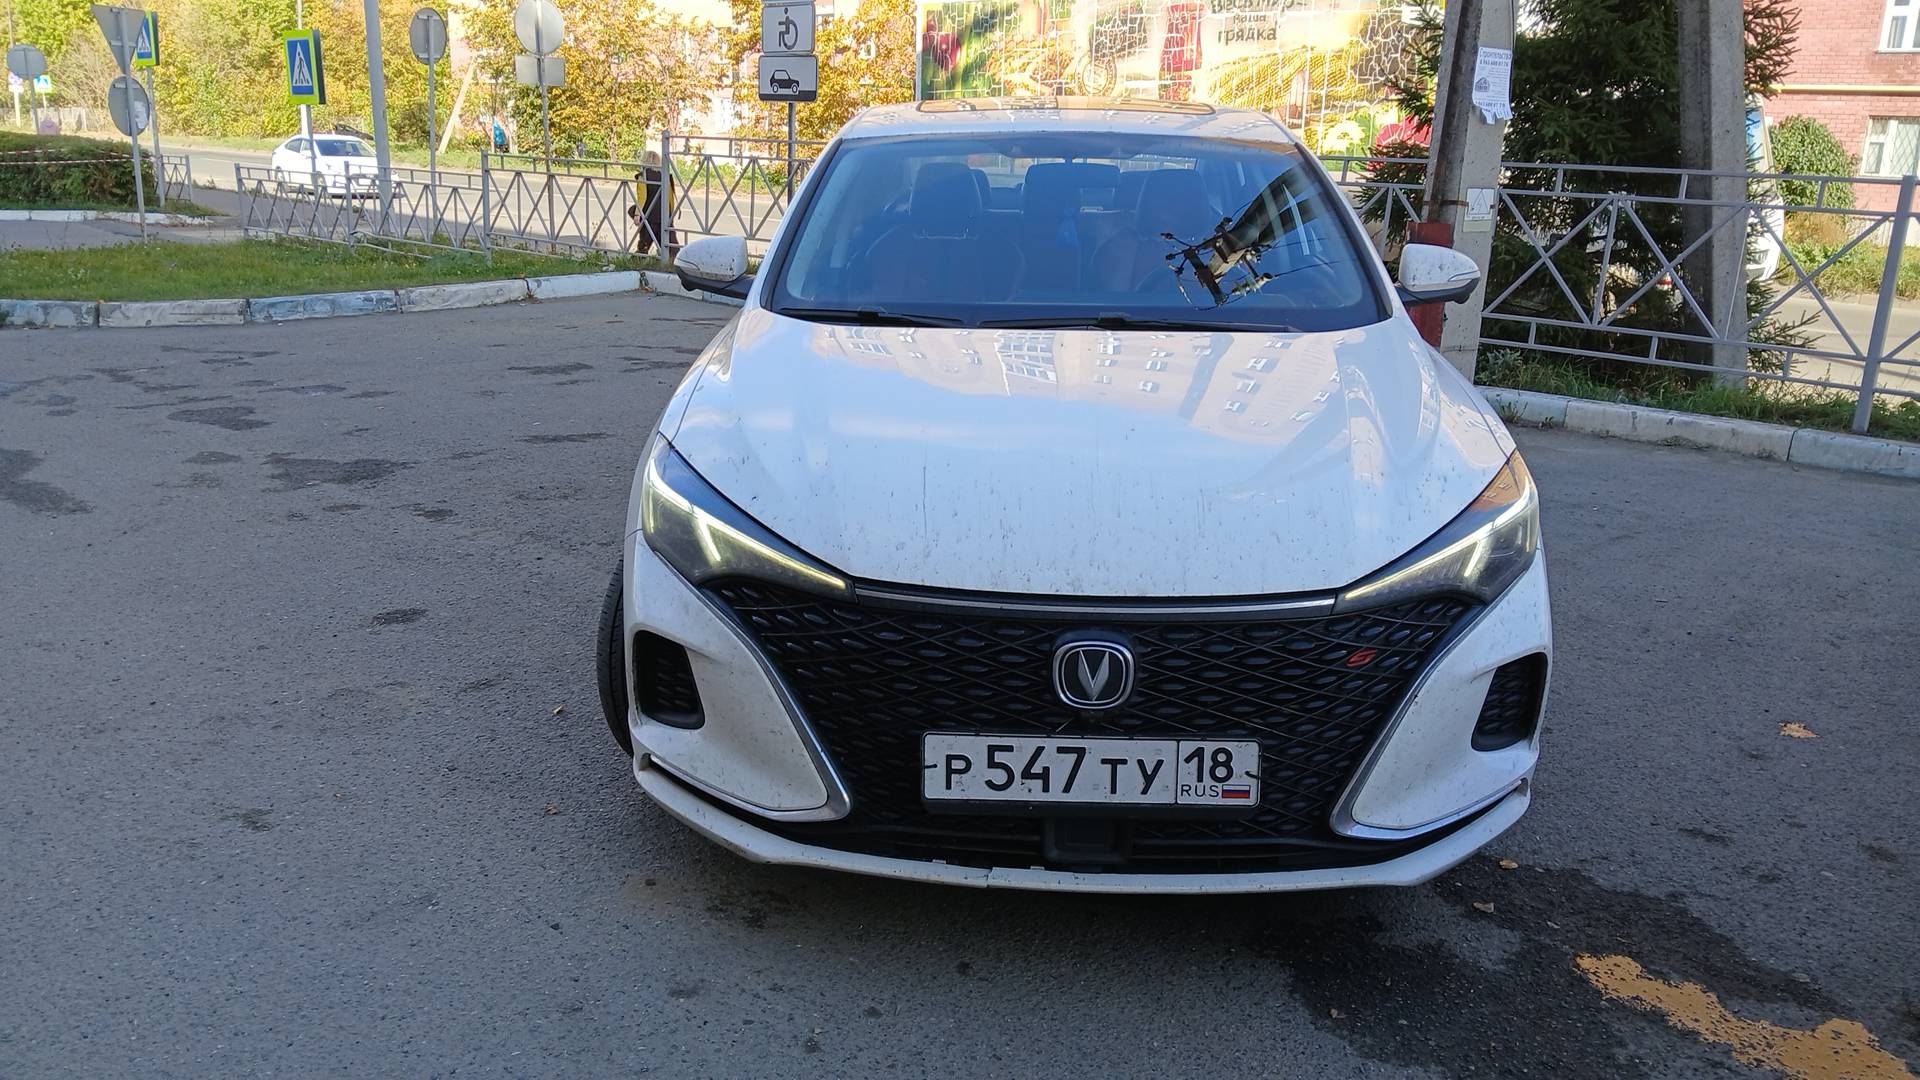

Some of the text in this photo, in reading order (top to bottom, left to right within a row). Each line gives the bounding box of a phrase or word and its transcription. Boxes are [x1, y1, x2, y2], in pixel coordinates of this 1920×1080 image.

[1218, 26, 1277, 45] грядка
[945, 744, 1165, 795] Р 547 ТУ
[1183, 746, 1235, 783] 18
[1180, 784, 1220, 798] RUS
